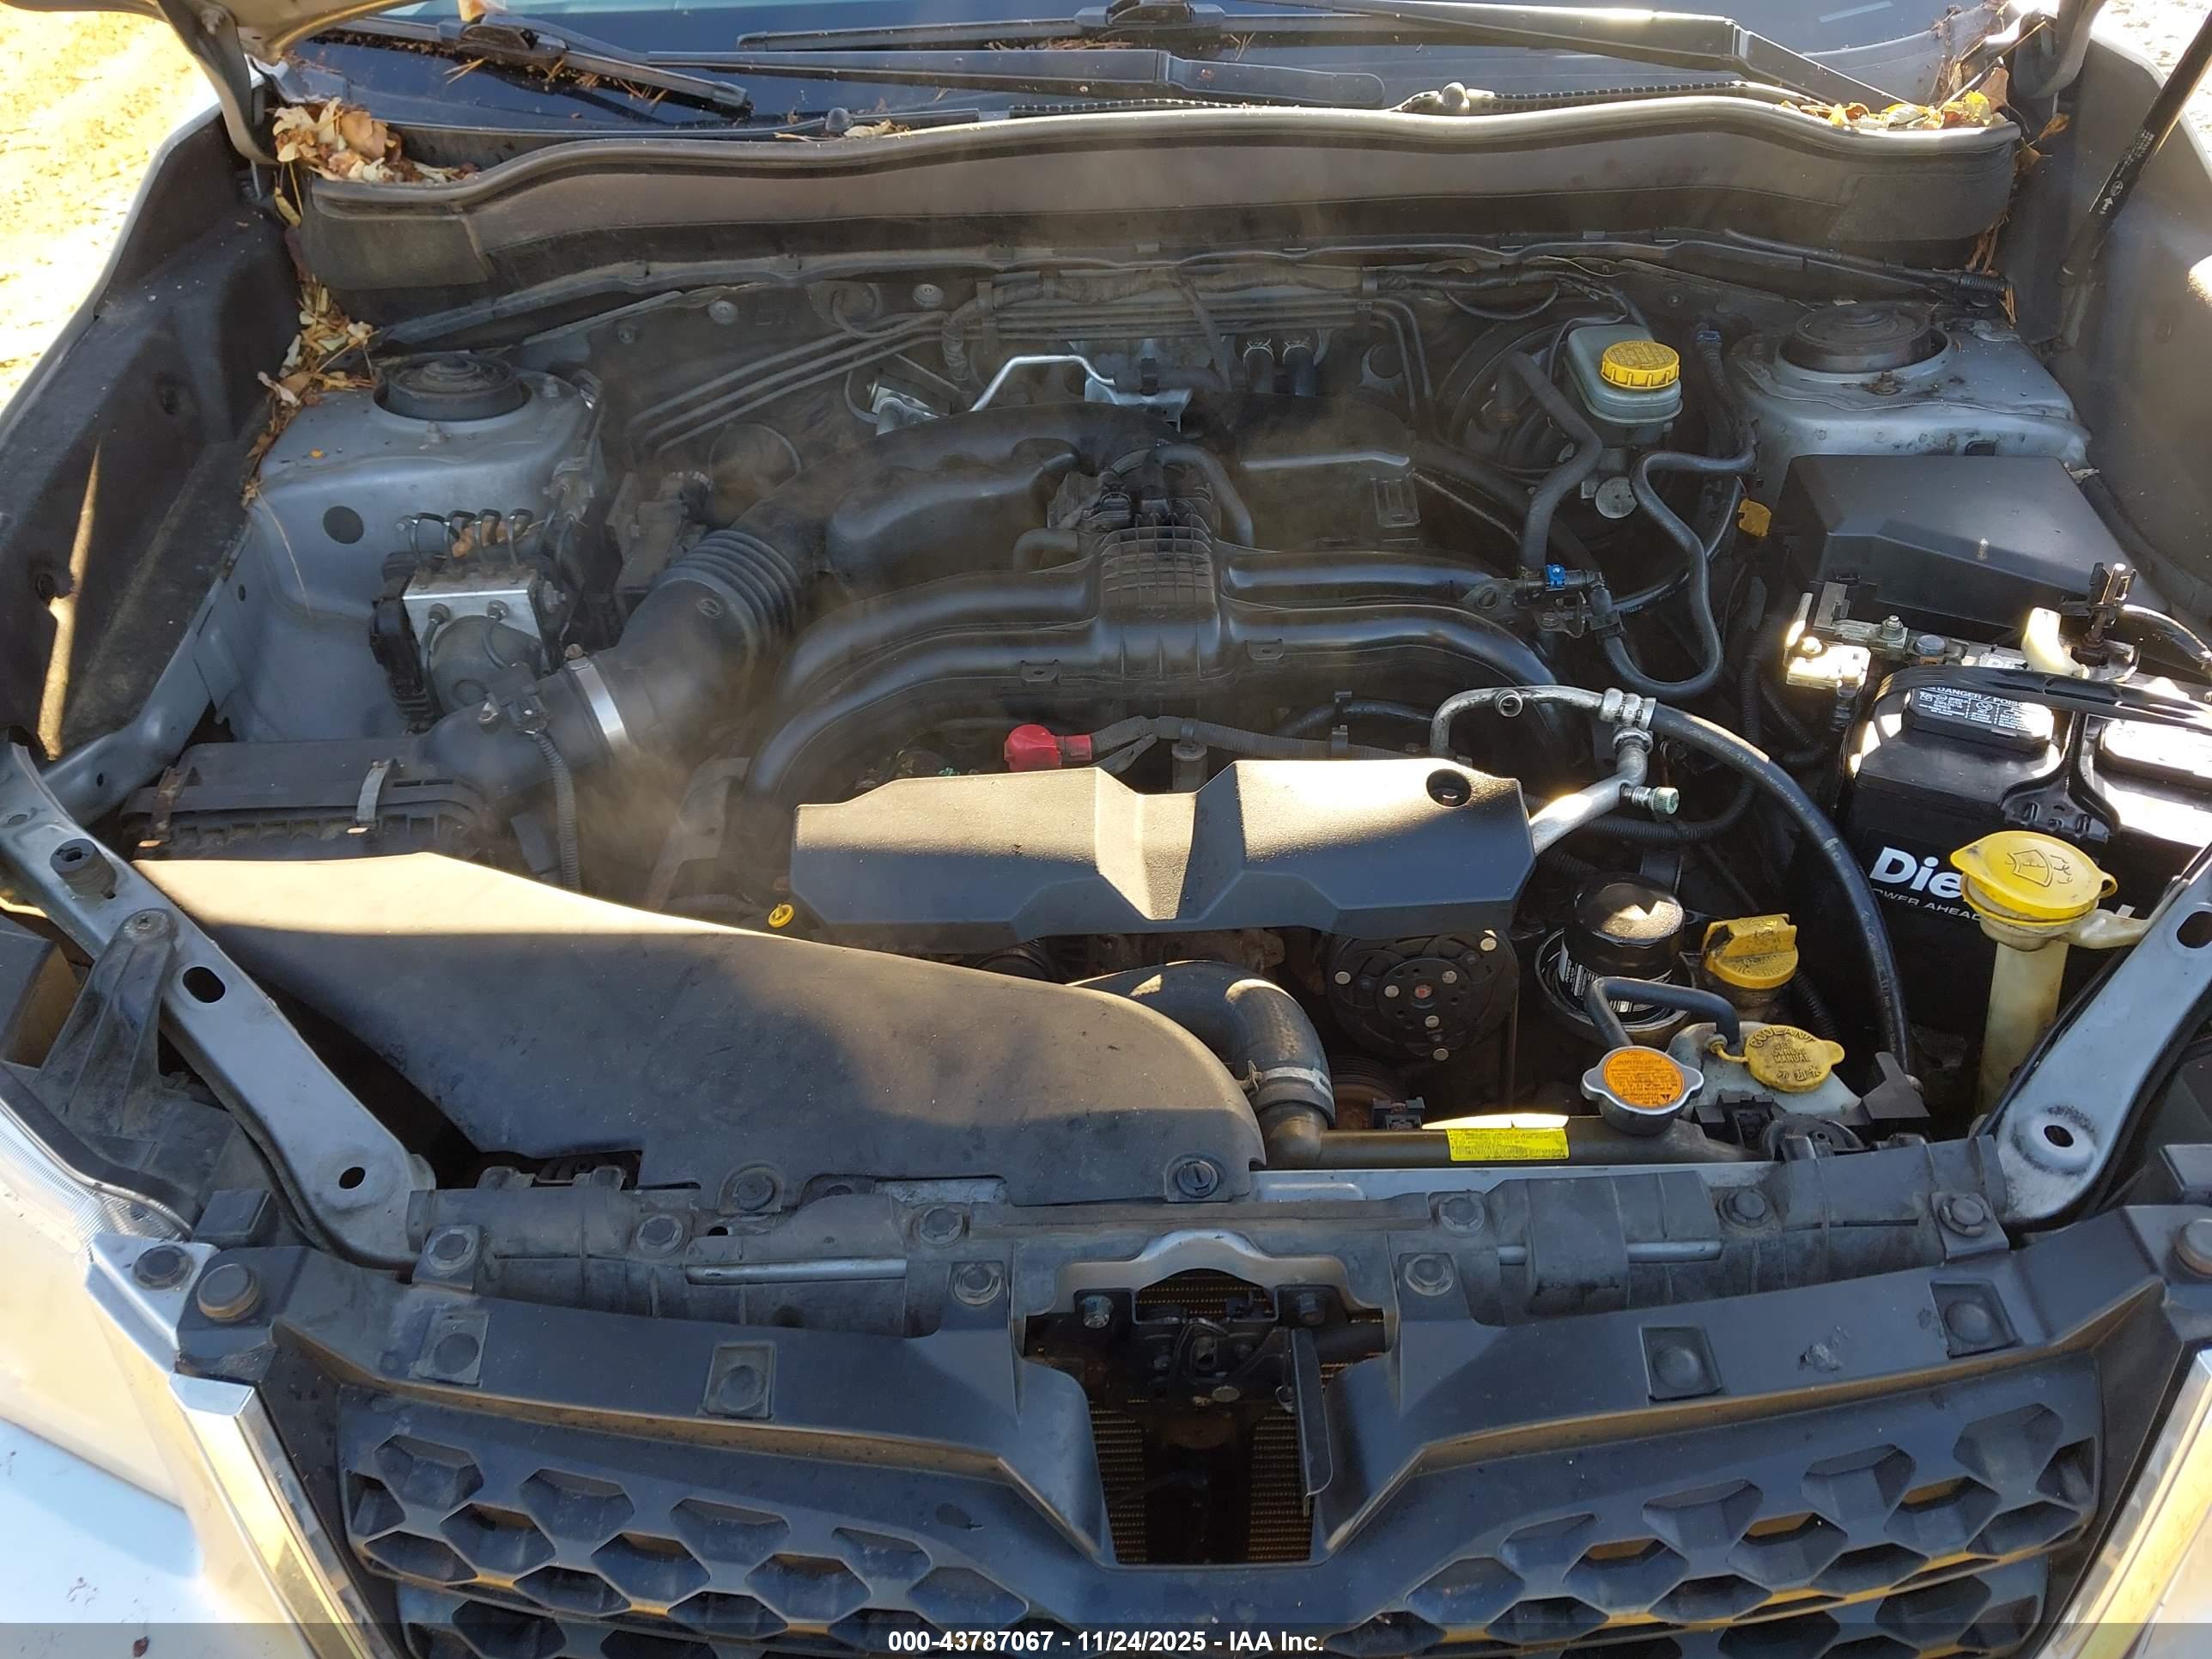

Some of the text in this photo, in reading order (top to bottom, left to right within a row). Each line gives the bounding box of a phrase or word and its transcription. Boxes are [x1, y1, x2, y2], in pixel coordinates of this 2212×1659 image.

[1992, 697, 2024, 708] POISO
[1923, 902, 1981, 921] AHEAD
[1749, 1026, 1817, 1048] COOLANT
